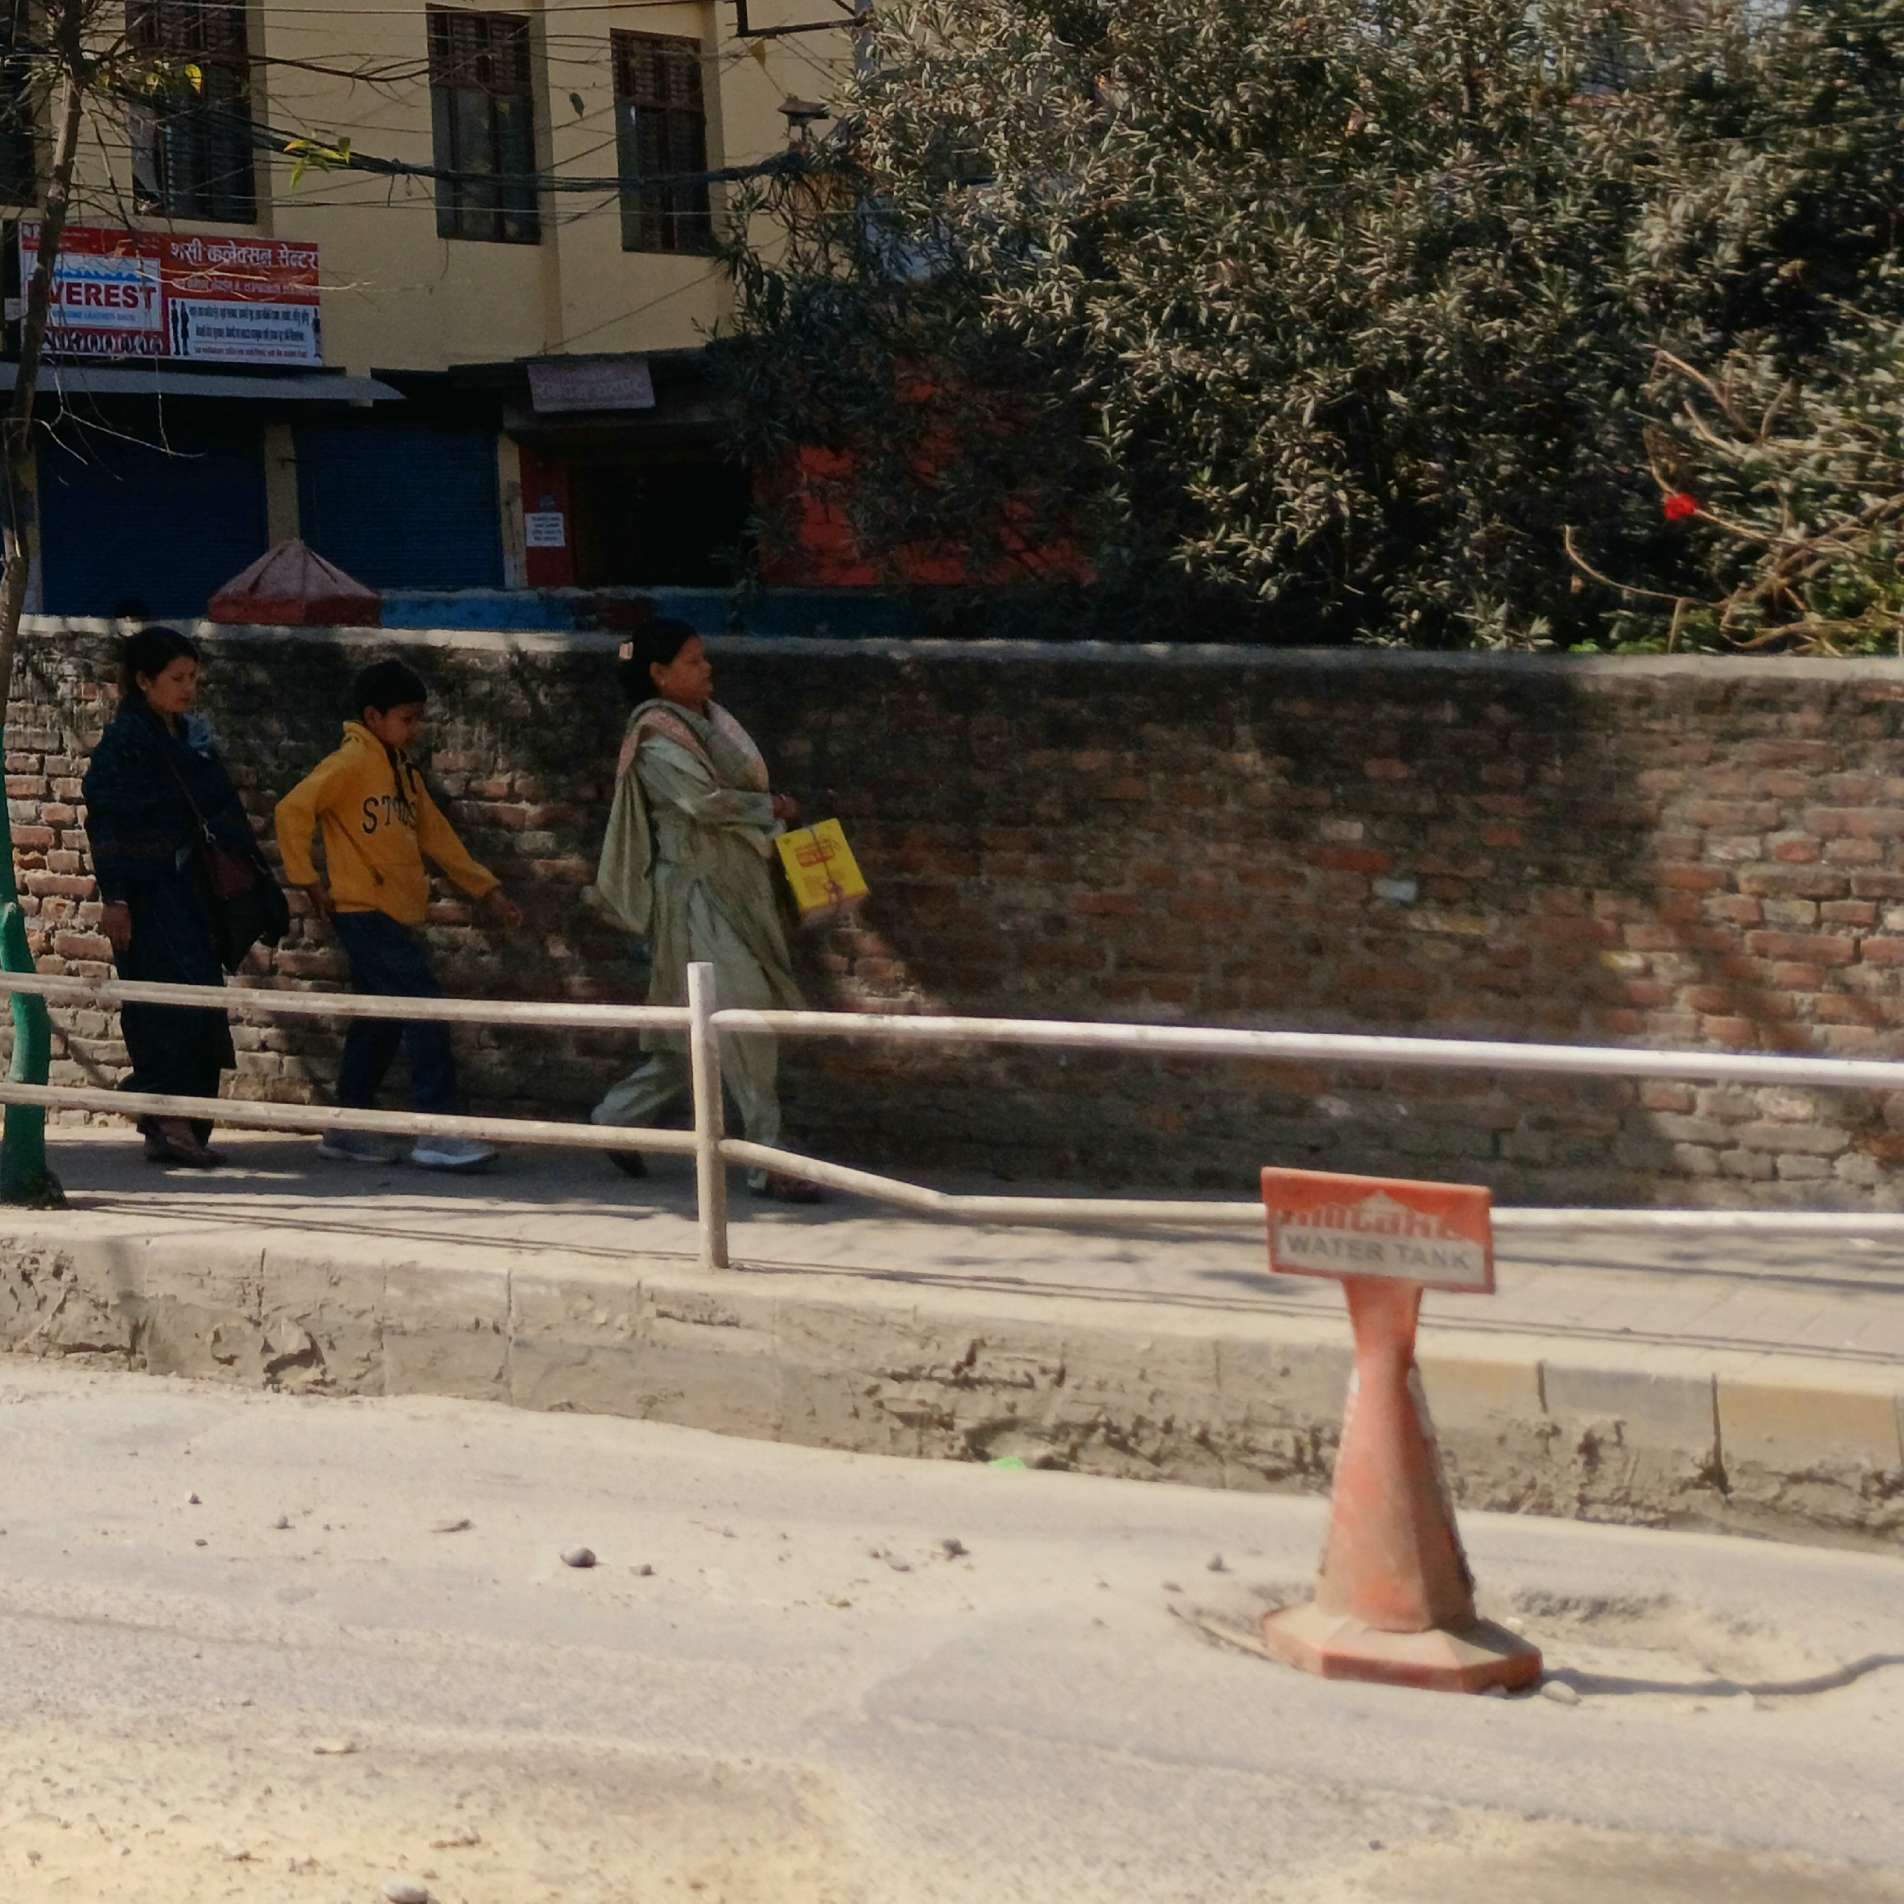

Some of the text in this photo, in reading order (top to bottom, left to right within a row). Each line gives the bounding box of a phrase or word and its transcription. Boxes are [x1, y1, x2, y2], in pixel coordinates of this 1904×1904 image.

[49, 279, 158, 311] VEREST
[1285, 1234, 1471, 1271] WATER TANK
